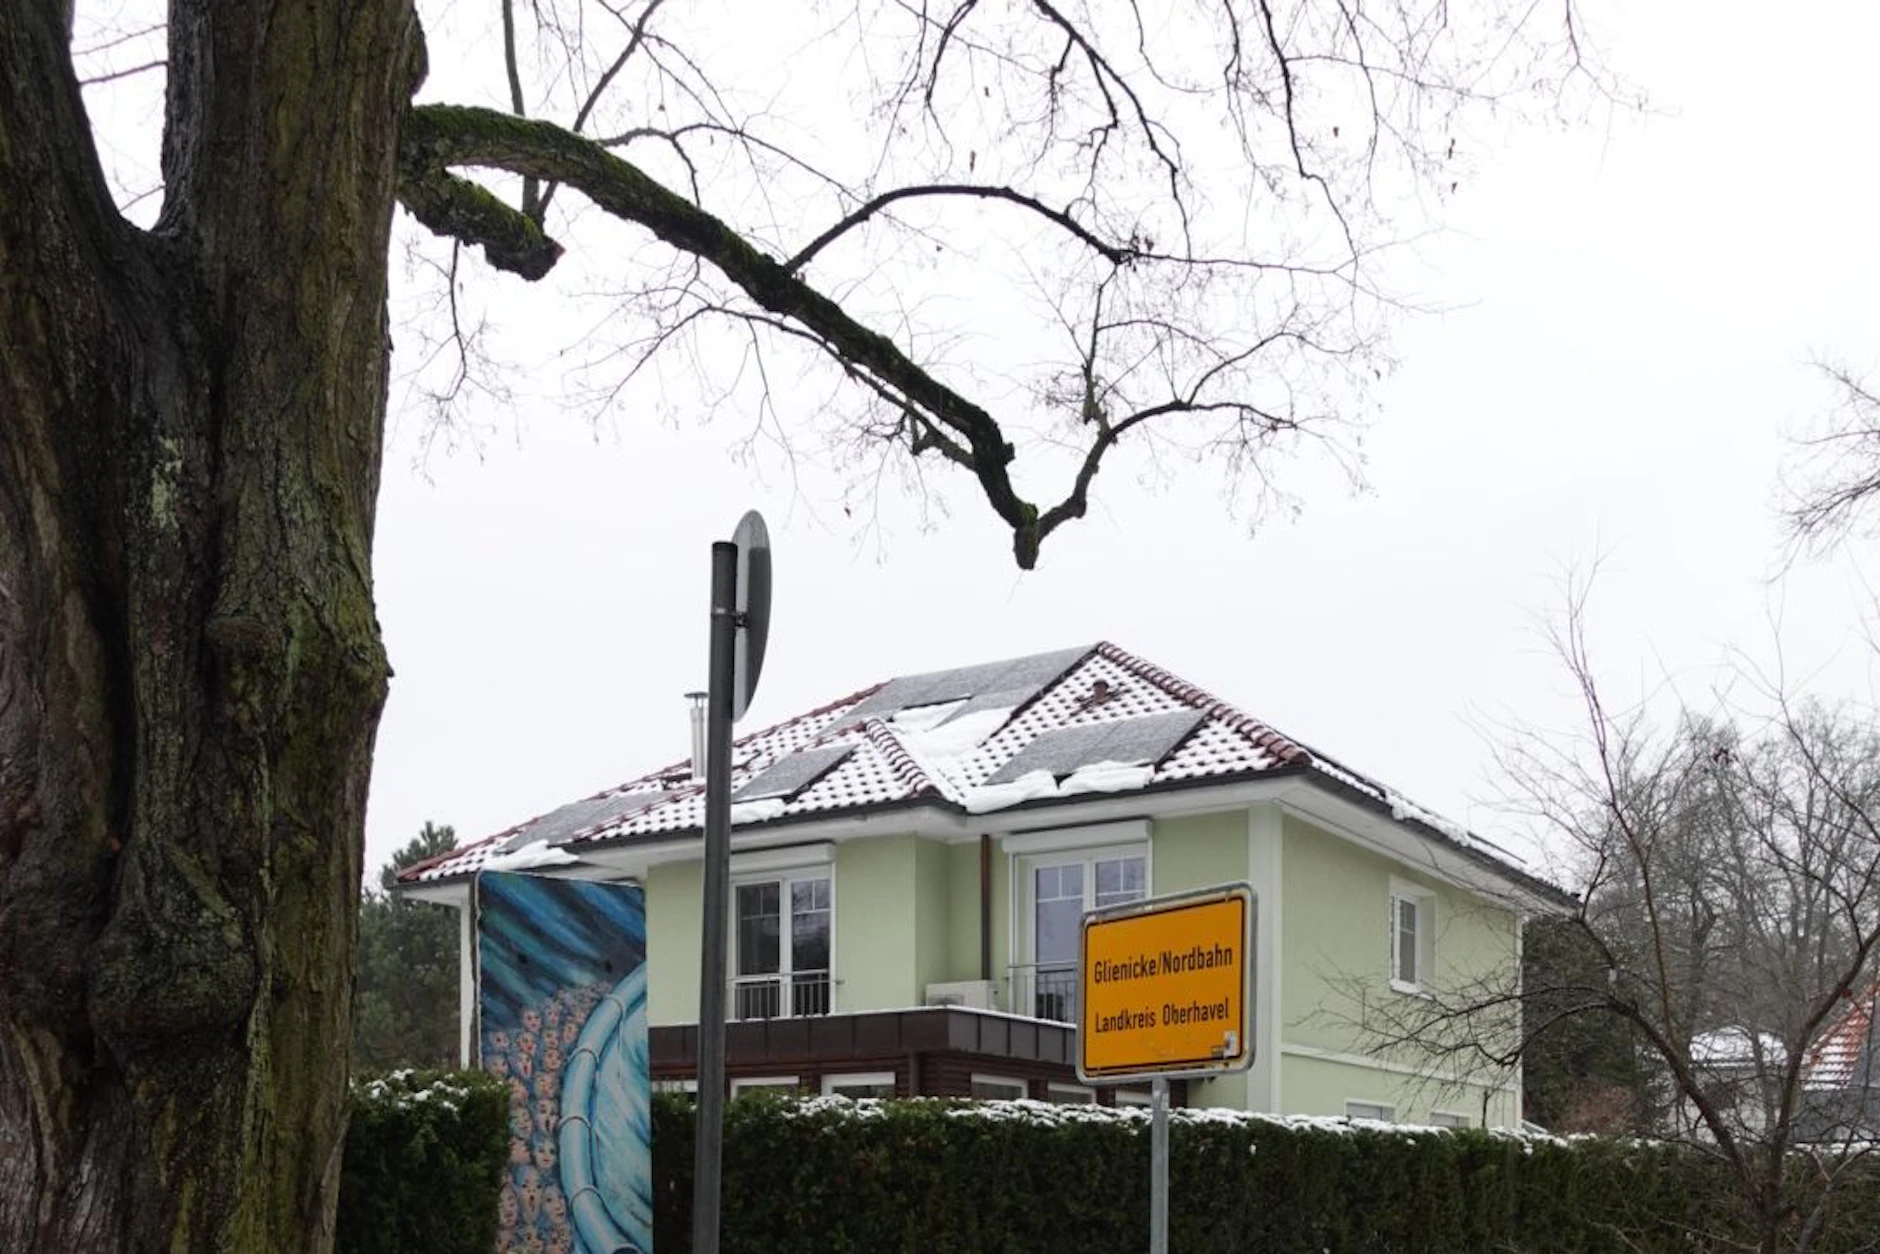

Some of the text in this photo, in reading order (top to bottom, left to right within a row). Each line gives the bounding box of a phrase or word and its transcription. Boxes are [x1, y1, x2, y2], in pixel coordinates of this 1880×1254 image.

[1094, 943, 1233, 984] Glienicke/Nordbahn
[1095, 997, 1229, 1033] Landkreis Oberhavel
